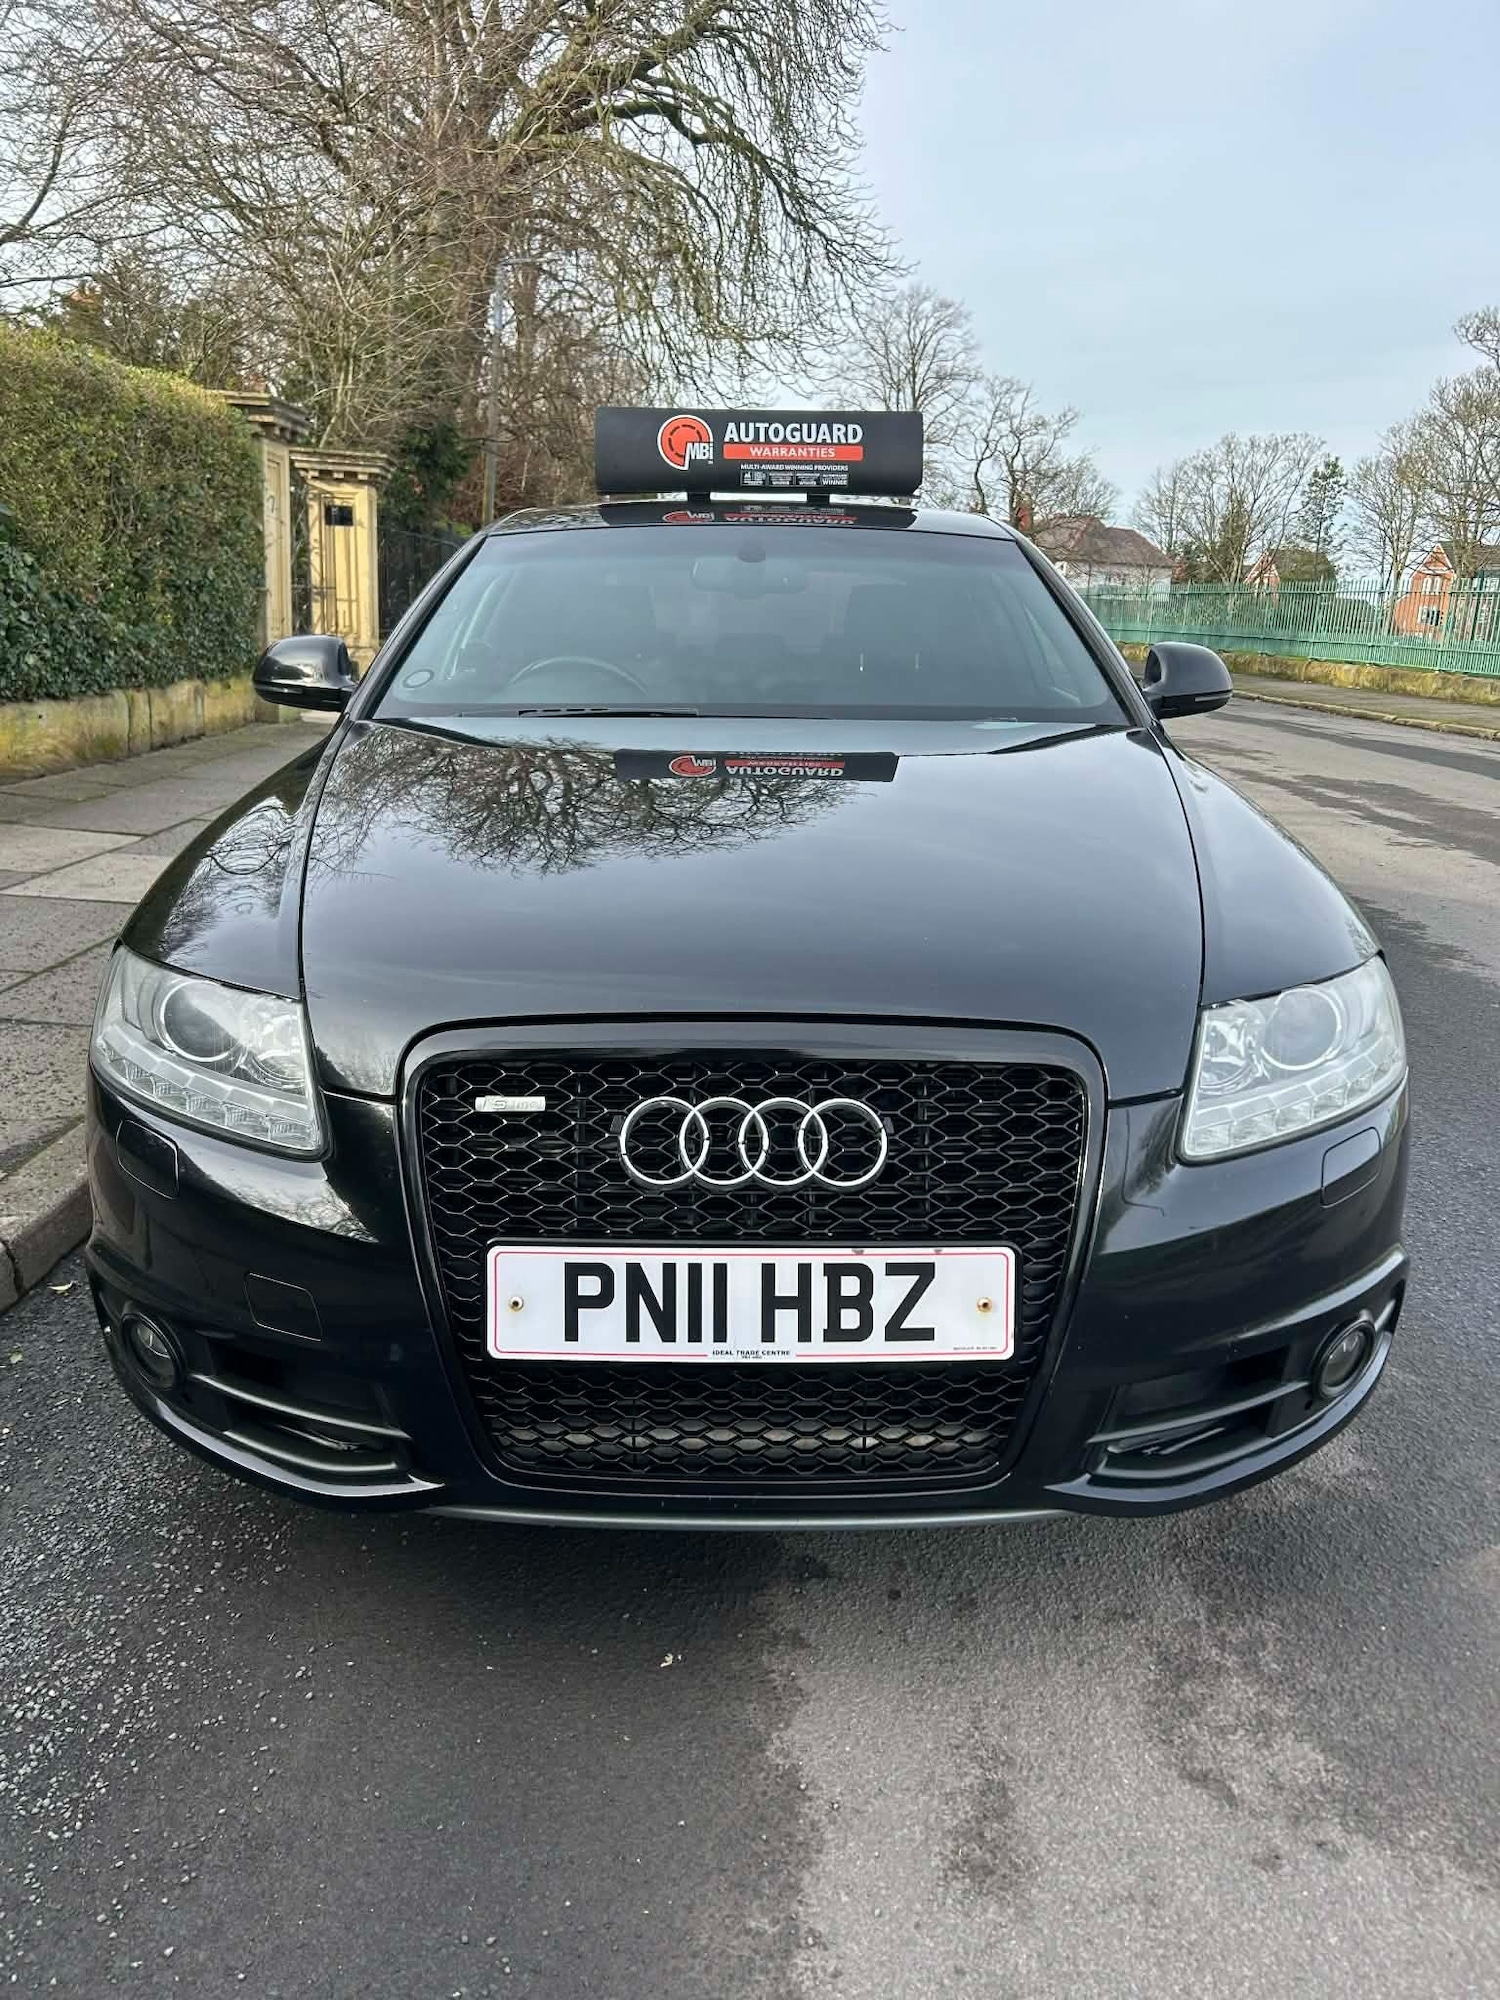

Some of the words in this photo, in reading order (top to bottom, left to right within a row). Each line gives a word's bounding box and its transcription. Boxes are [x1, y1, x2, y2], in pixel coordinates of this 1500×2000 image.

[723, 422, 863, 444] AUTOGUARD
[750, 446, 836, 458] WARRANTIES
[740, 463, 784, 471] MULTI-AWARD
[814, 464, 849, 472] PROVIDERS
[564, 1262, 728, 1343] PN11
[761, 1262, 936, 1343] HBZ
